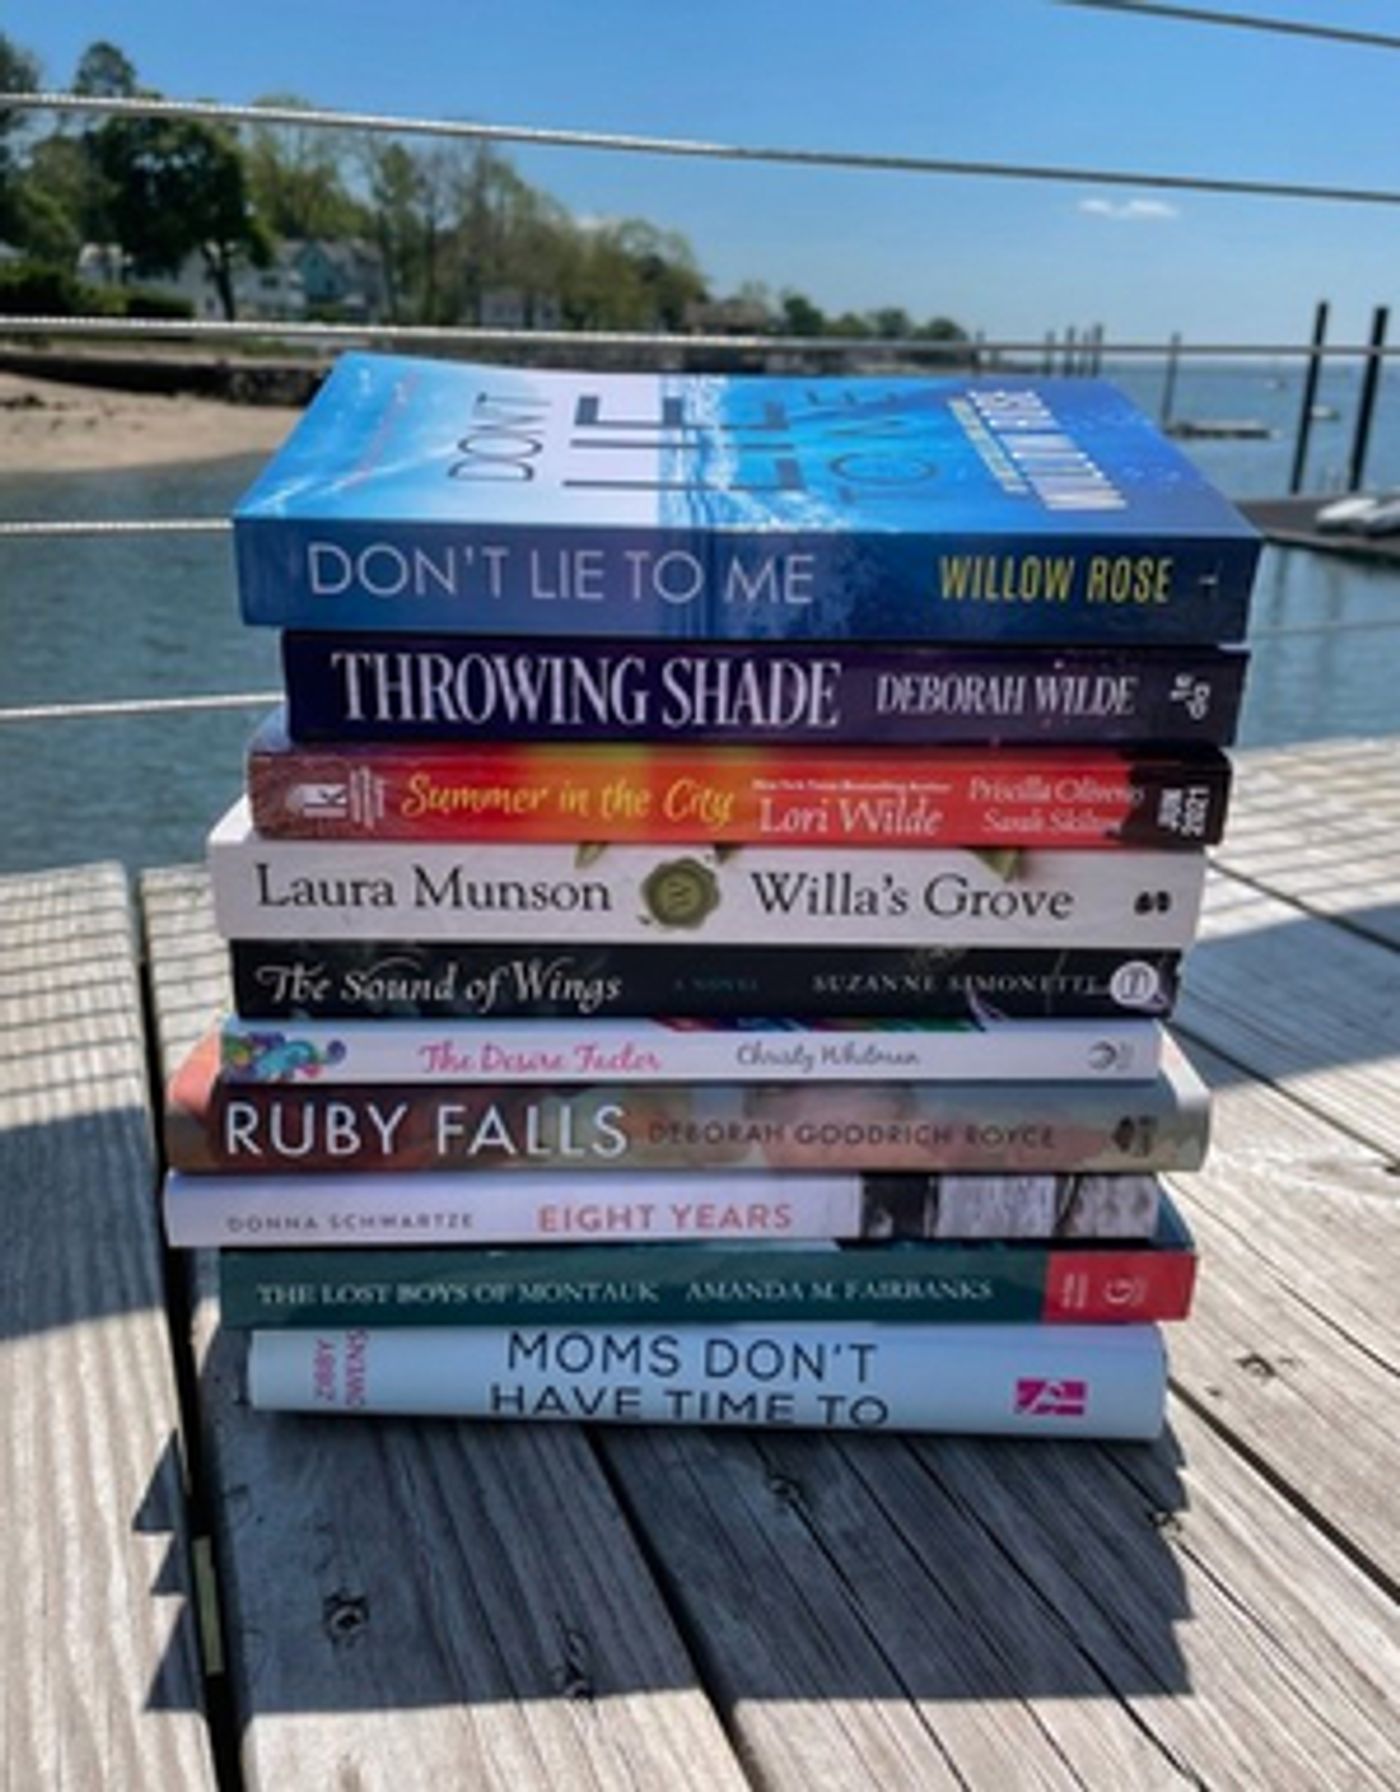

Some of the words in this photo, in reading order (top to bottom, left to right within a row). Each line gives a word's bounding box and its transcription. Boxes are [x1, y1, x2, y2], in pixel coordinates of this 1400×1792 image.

[308, 543, 508, 596] DON'T
[531, 550, 604, 599] LIE
[624, 551, 705, 603] TO
[726, 555, 815, 604] ME
[939, 556, 1074, 601] WILLOW
[1086, 557, 1173, 602] ROSE
[332, 651, 649, 726] THROWING
[662, 656, 841, 728] SHADE
[876, 675, 1024, 715] DEBORAH
[1033, 674, 1138, 715] WILDE
[402, 774, 550, 815] Summer
[560, 779, 589, 812] in
[600, 779, 650, 816] the
[663, 778, 734, 827] City
[760, 796, 828, 834] Lori
[839, 796, 945, 836] Wilde
[256, 864, 396, 909] Laura
[411, 865, 613, 912] Munson
[751, 871, 909, 918] Willa's
[924, 873, 1075, 919] Grove
[256, 963, 329, 1004] The
[341, 955, 457, 1004] Sound
[466, 964, 506, 1015] of
[506, 957, 622, 1015] Wings
[812, 974, 933, 992] SUZANNE
[420, 1039, 472, 1073] The
[225, 1102, 407, 1157] RUBY
[437, 1103, 629, 1157] FALLS
[647, 1120, 785, 1146] DEBORAH
[794, 1120, 952, 1147] GOODRICH
[965, 1120, 1055, 1147] ROYCE
[227, 1214, 319, 1233] DONNA
[328, 1211, 474, 1231] SCHWARTZE
[537, 1204, 656, 1234] EIGHT
[670, 1202, 793, 1232] YEARS
[256, 1282, 314, 1304] THE
[321, 1282, 388, 1304] LOST
[397, 1282, 469, 1304] BOYS
[471, 1282, 509, 1303] OF
[516, 1280, 661, 1304] MONTAUK
[685, 1280, 804, 1302] AMANDA
[844, 1278, 995, 1301] FAIRBANKS
[508, 1331, 682, 1378] MOMS
[704, 1338, 878, 1383] DON'T
[491, 1385, 643, 1418] HAVE
[665, 1389, 796, 1422] TIME
[818, 1395, 890, 1426] TO
